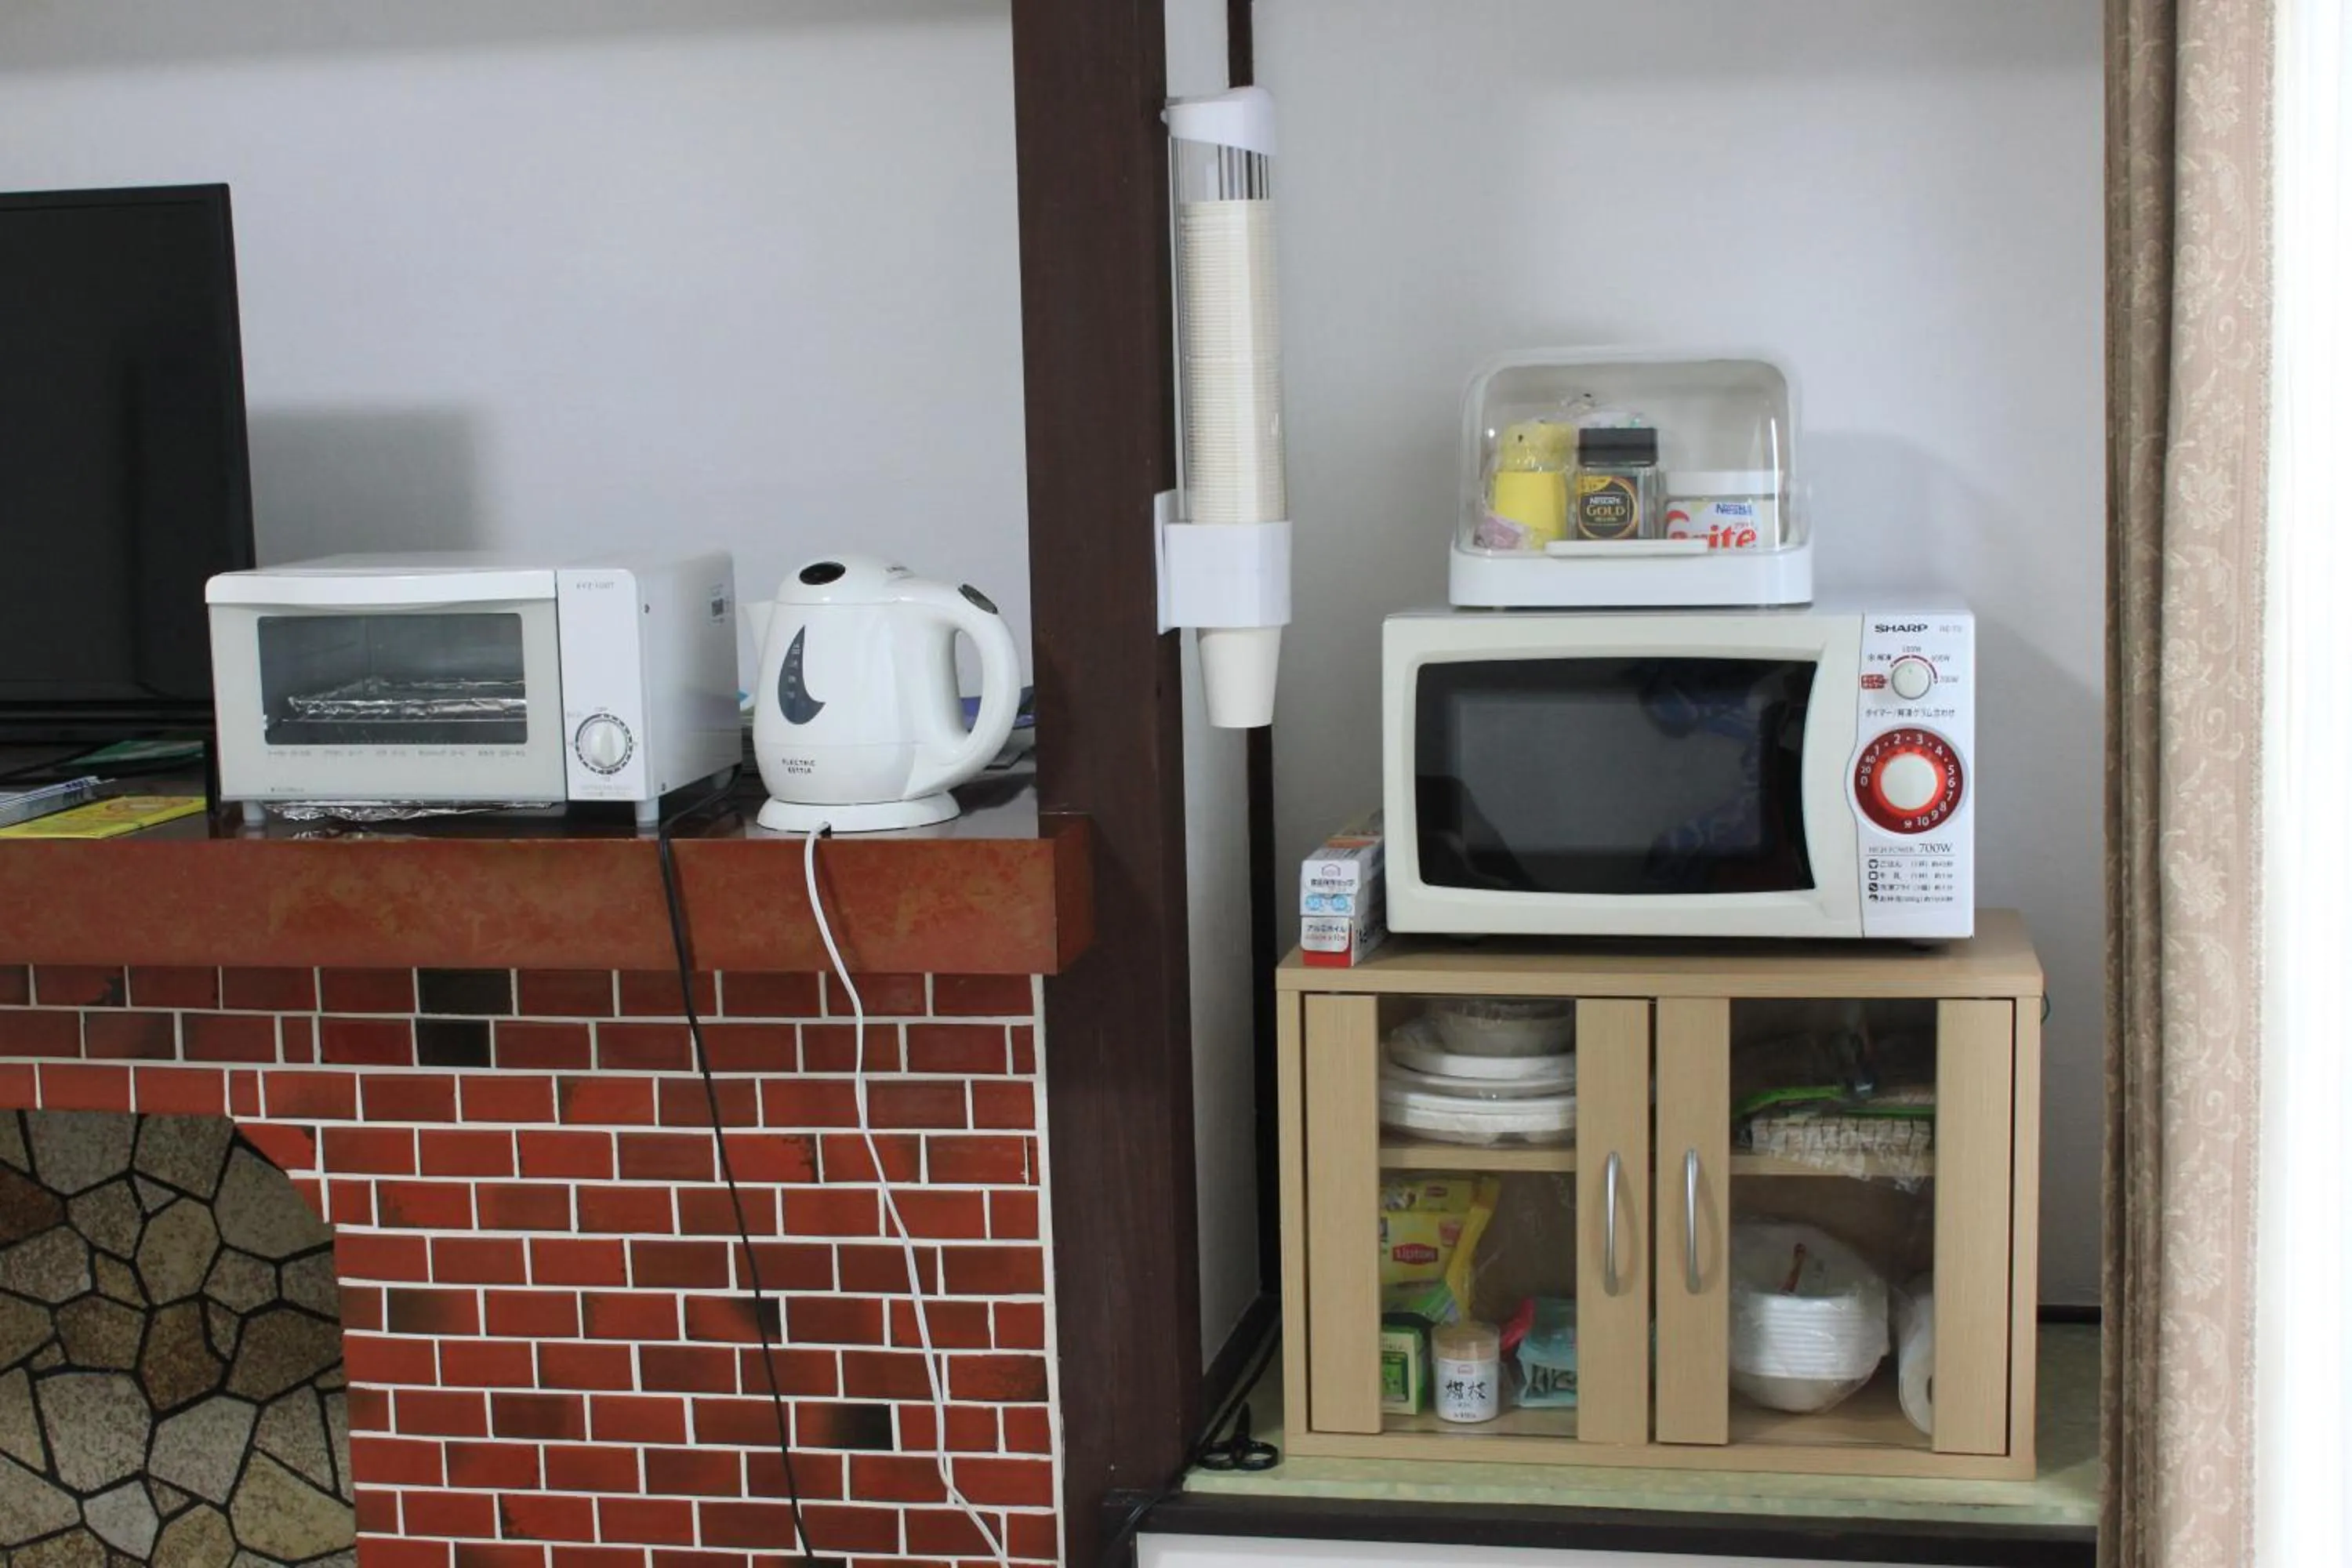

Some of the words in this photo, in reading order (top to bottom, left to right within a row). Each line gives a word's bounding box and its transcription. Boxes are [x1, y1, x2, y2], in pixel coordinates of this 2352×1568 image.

[1586, 505, 1626, 517] GOLD
[1875, 623, 1929, 633] SHARP
[1893, 733, 1901, 744] 2
[1916, 733, 1923, 745] 3
[1934, 746, 1944, 757] 4
[1860, 765, 1871, 774] 20
[1947, 764, 1955, 775] 5
[1860, 776, 1868, 786] 0
[1947, 777, 1956, 788] 6
[1946, 790, 1954, 801] 7
[1939, 800, 1947, 812] 8
[1917, 816, 1929, 826] 10
[1931, 810, 1939, 821] 9
[1918, 843, 1954, 853] 700W
[1396, 1247, 1436, 1261] Lipton
